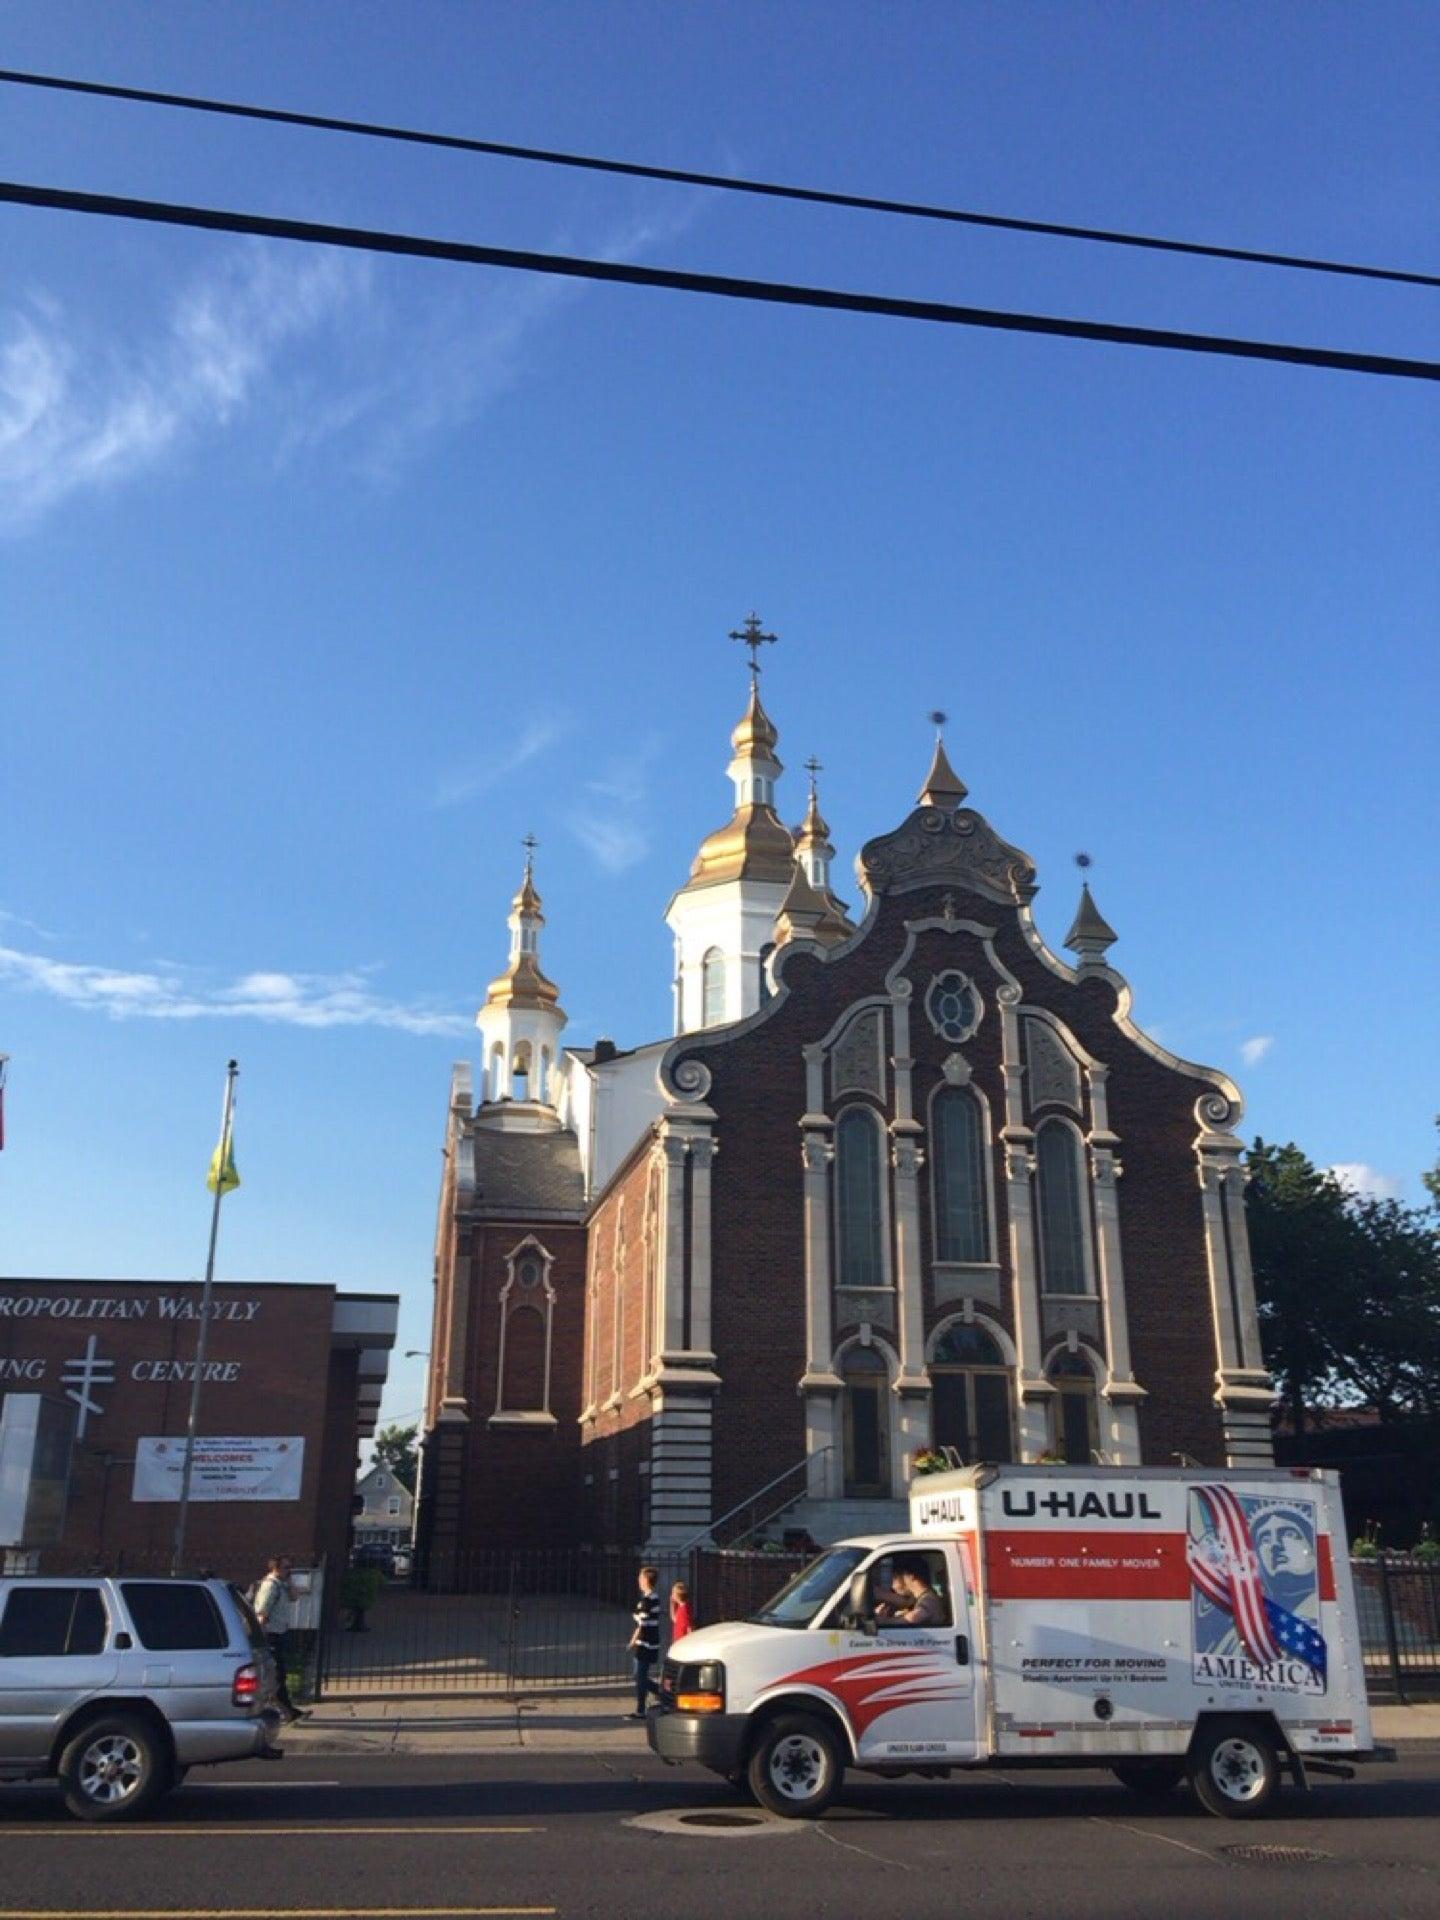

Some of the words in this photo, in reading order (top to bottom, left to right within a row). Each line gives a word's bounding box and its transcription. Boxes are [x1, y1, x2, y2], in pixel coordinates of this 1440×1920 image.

[131, 1360, 241, 1381] CENTRE
[919, 1496, 966, 1526] U-HAUL
[1002, 1490, 1162, 1519] U-HAUL
[1011, 1557, 1055, 1568] NUMBER
[1059, 1558, 1082, 1568] ONE
[1083, 1558, 1118, 1568] FAMILY
[1122, 1558, 1160, 1568] MOVER
[1022, 1658, 1081, 1668] PERFECT
[1084, 1658, 1110, 1668] FOR
[1115, 1658, 1167, 1668] MOVING
[1195, 1655, 1321, 1687] AMERICA
